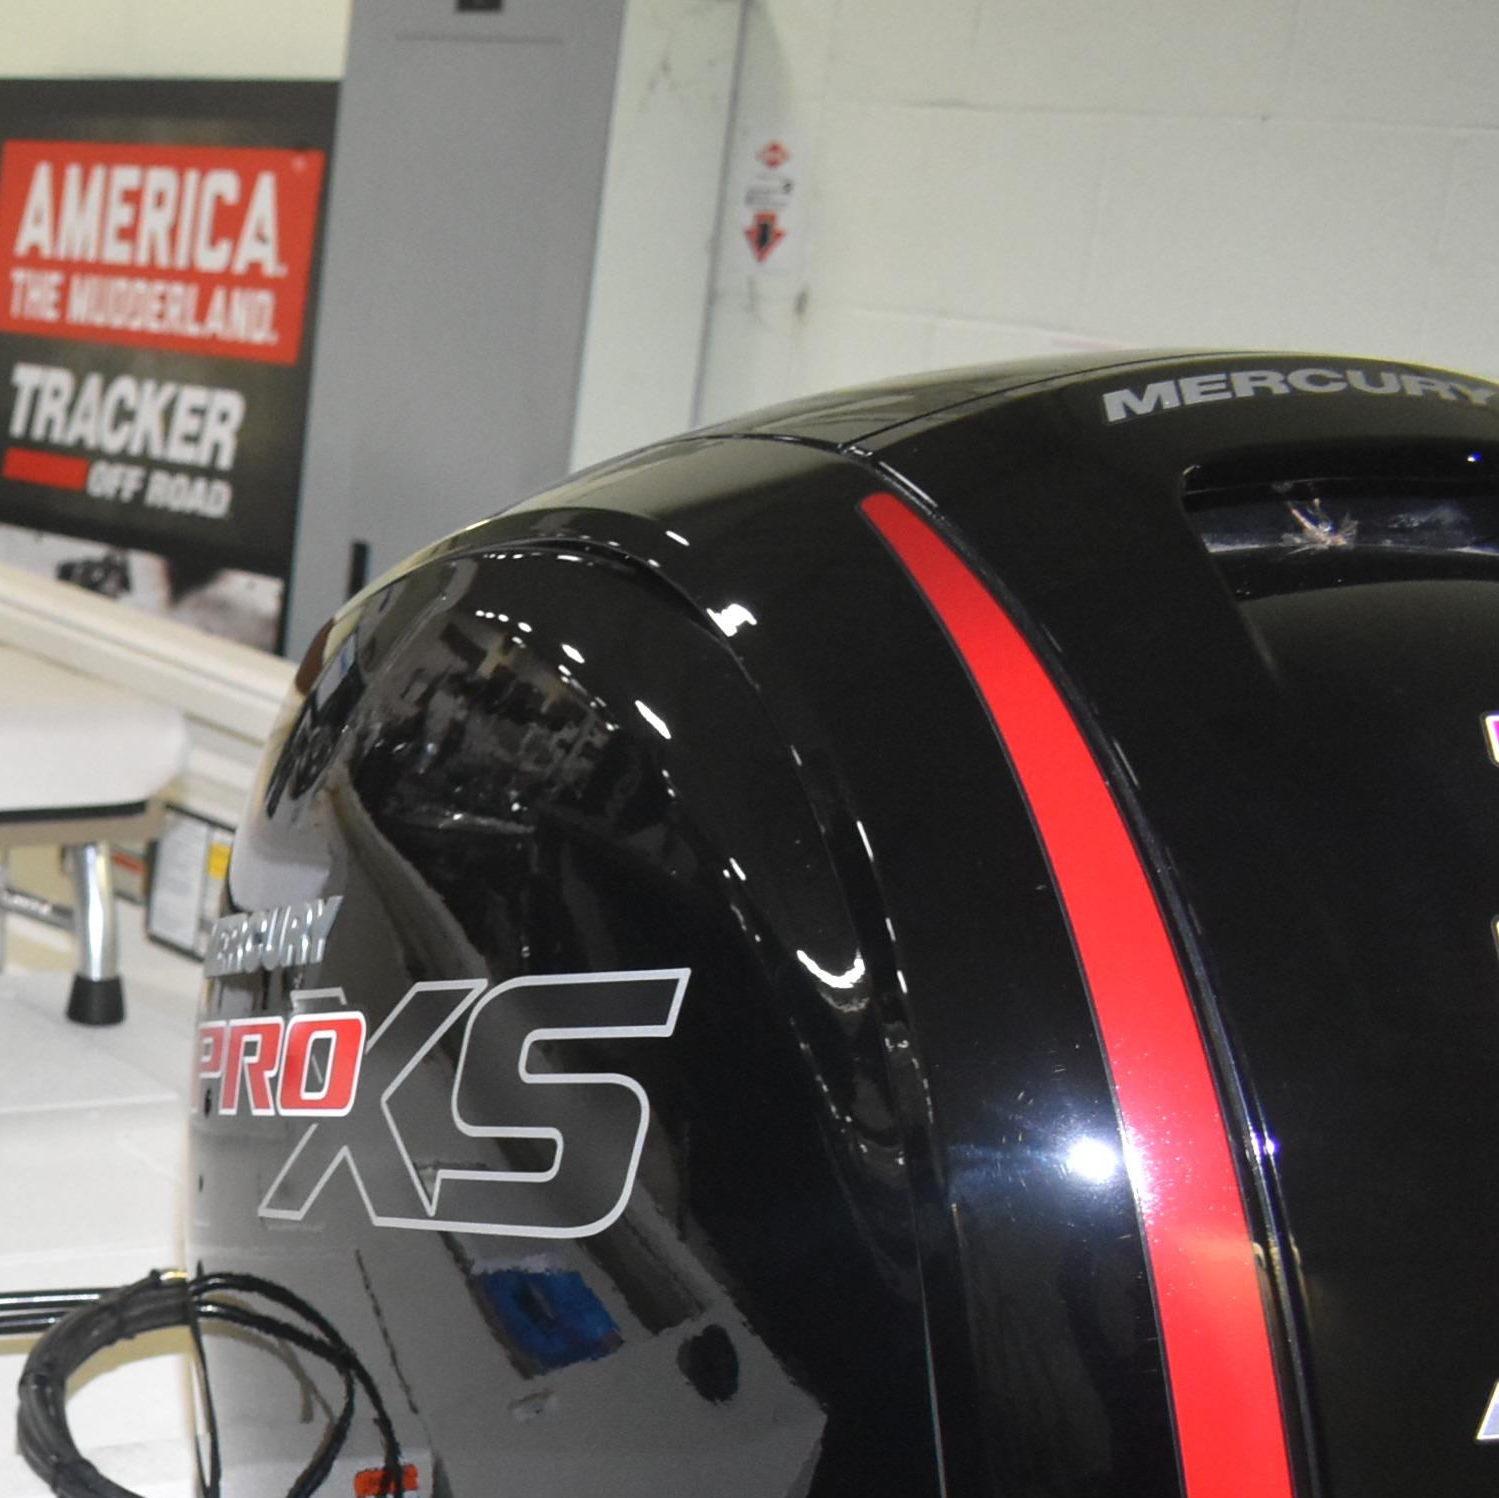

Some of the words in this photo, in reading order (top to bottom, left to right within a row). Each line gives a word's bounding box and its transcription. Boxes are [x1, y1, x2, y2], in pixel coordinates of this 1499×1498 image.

[10, 267, 64, 322] THE
[9, 361, 246, 471] TRACKER
[1102, 367, 1498, 425] MERCURY
[86, 460, 143, 503] OFF
[144, 471, 232, 520] ROAD
[191, 1010, 367, 1117] PRO
[256, 966, 692, 1240] XS
